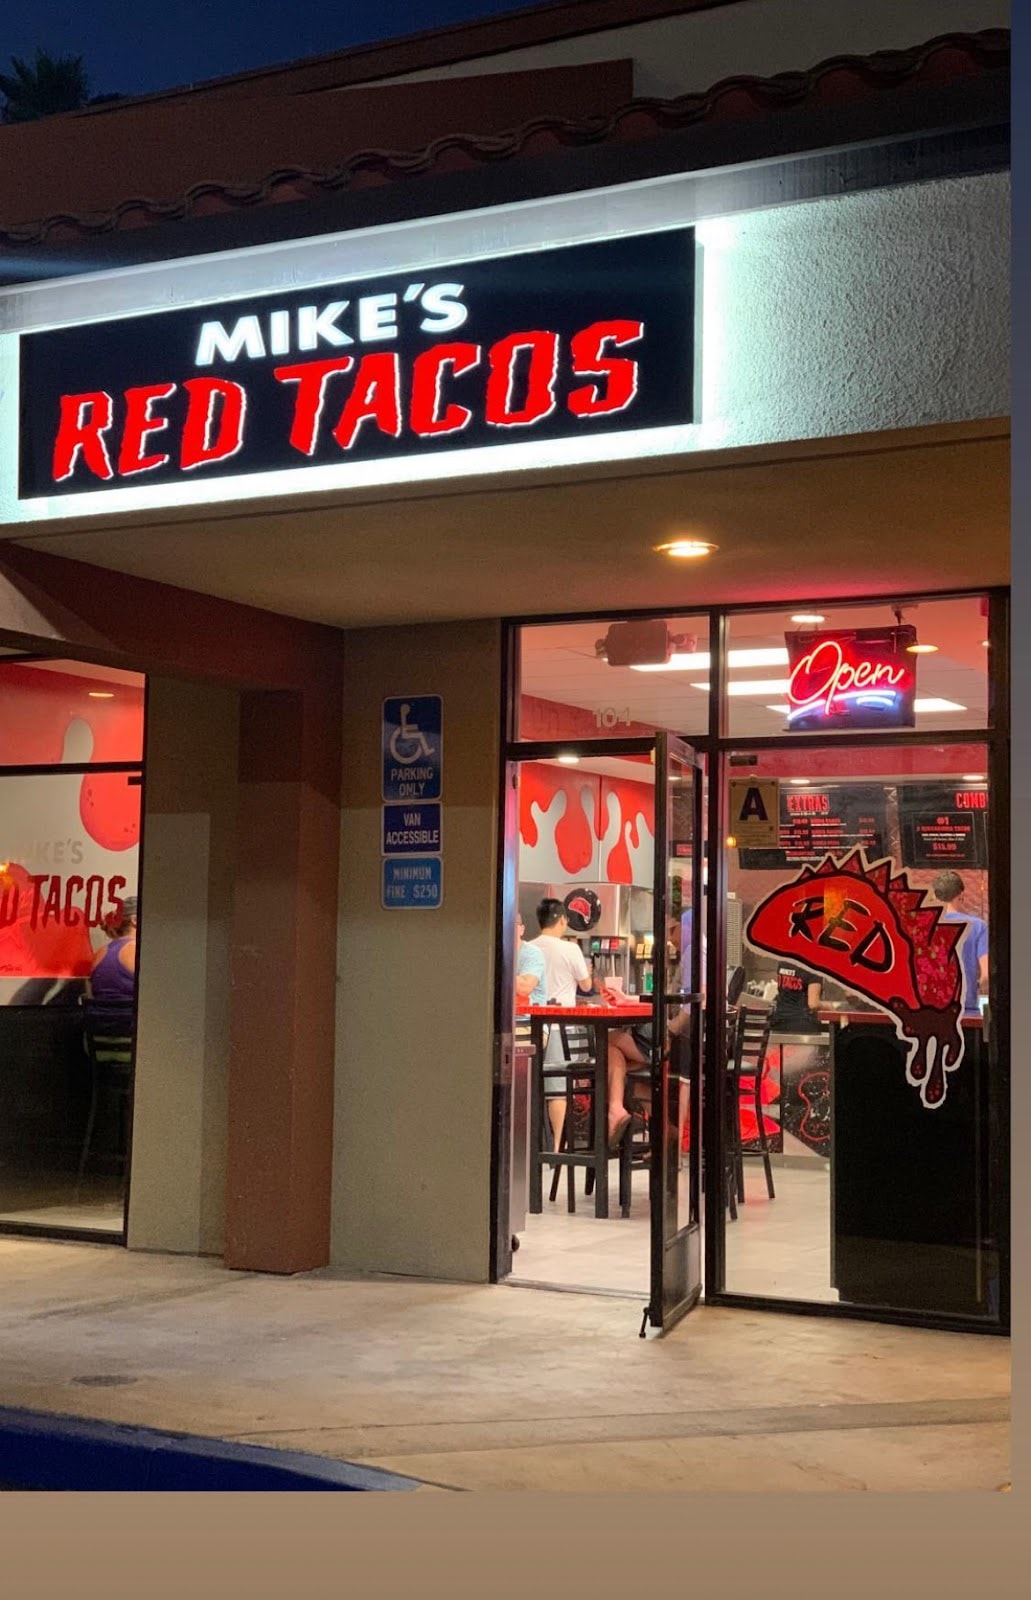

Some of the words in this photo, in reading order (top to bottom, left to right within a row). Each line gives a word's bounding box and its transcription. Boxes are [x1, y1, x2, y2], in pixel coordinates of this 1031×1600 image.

[194, 283, 469, 366] MIKE'S
[52, 377, 247, 482] RED
[274, 319, 645, 456] TACOS
[788, 640, 906, 716] Open
[592, 707, 633, 728] 104
[391, 767, 433, 780] PARKING
[399, 783, 425, 796] ONLY
[739, 787, 769, 821] A
[787, 793, 829, 811] EXTRAS
[956, 792, 988, 808] COMB
[404, 813, 421, 826] VAN
[386, 831, 438, 844] ACCESSIBLE
[393, 867, 431, 880] MINIMUM
[387, 886, 405, 898] FINE
[28, 874, 127, 932] TACOS
[788, 897, 895, 973] RED
